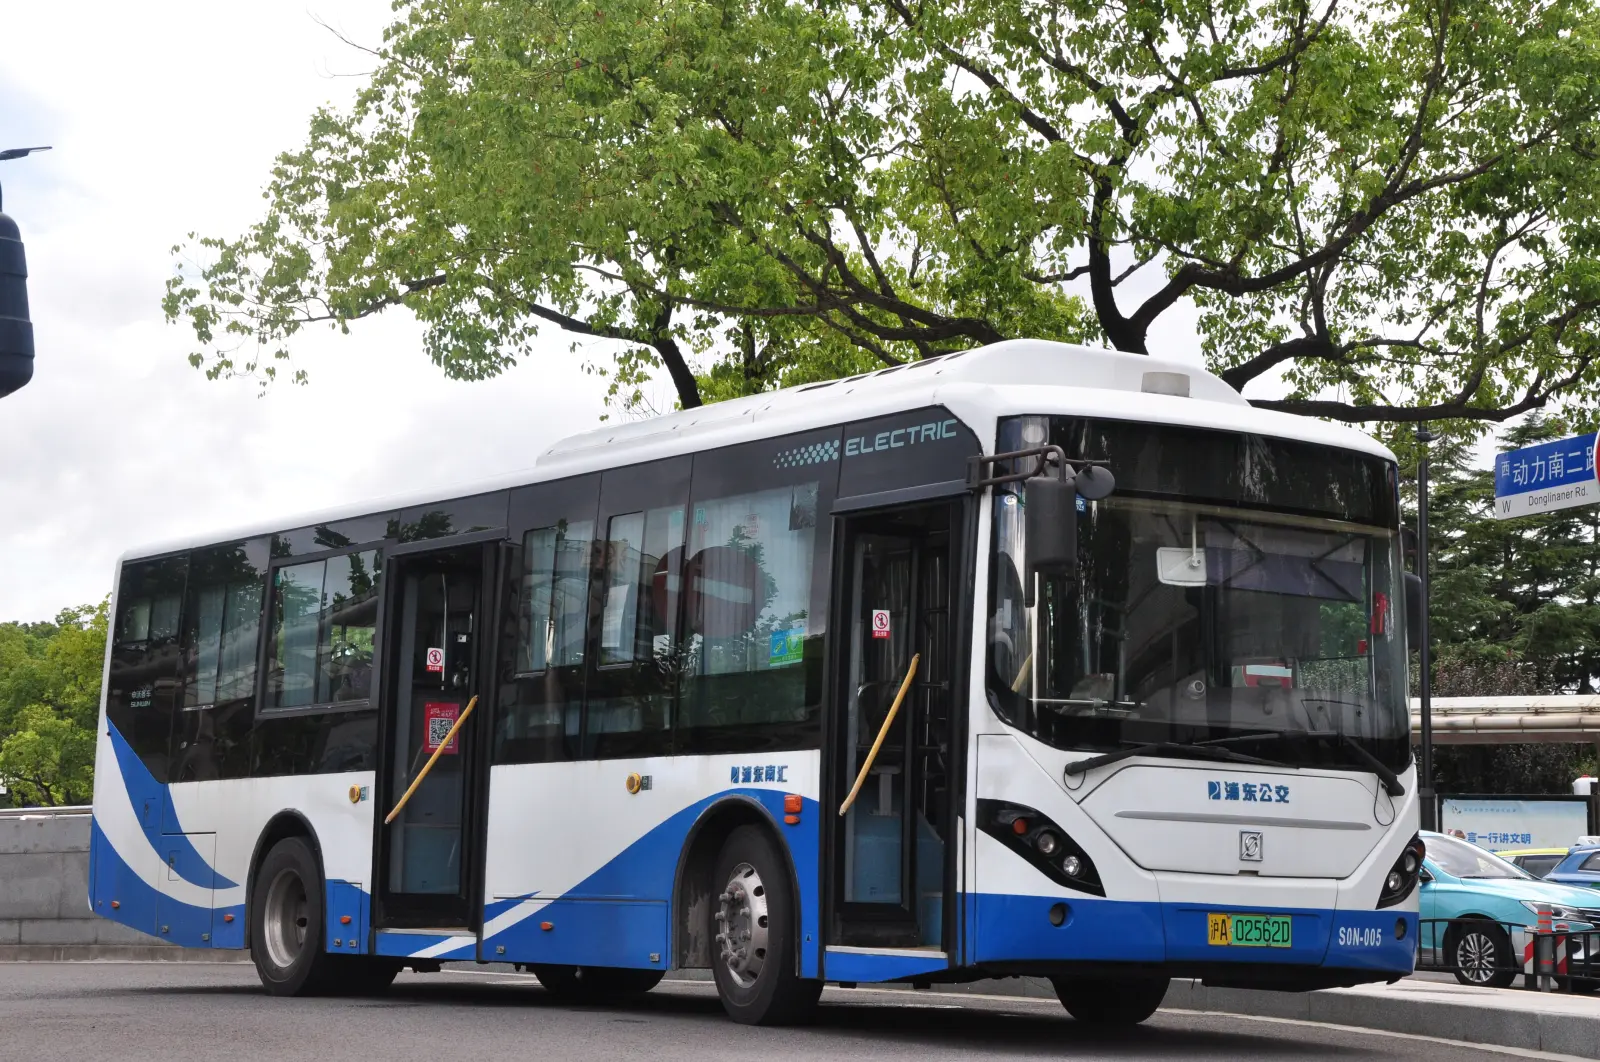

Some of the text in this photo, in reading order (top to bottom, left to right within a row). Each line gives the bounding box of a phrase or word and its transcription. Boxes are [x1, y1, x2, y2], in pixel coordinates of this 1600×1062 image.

[845, 419, 957, 456] ELECTRIC
[1501, 461, 1511, 477] 西
[1502, 486, 1588, 513] W Donglinaner Rd.
[130, 700, 151, 708] SUNWIN
[741, 765, 788, 783] 浦东南汇
[1224, 781, 1290, 803] 浦东公交
[1466, 832, 1531, 844] 言一行讲文明
[1210, 918, 1290, 943] 沪A 02562D
